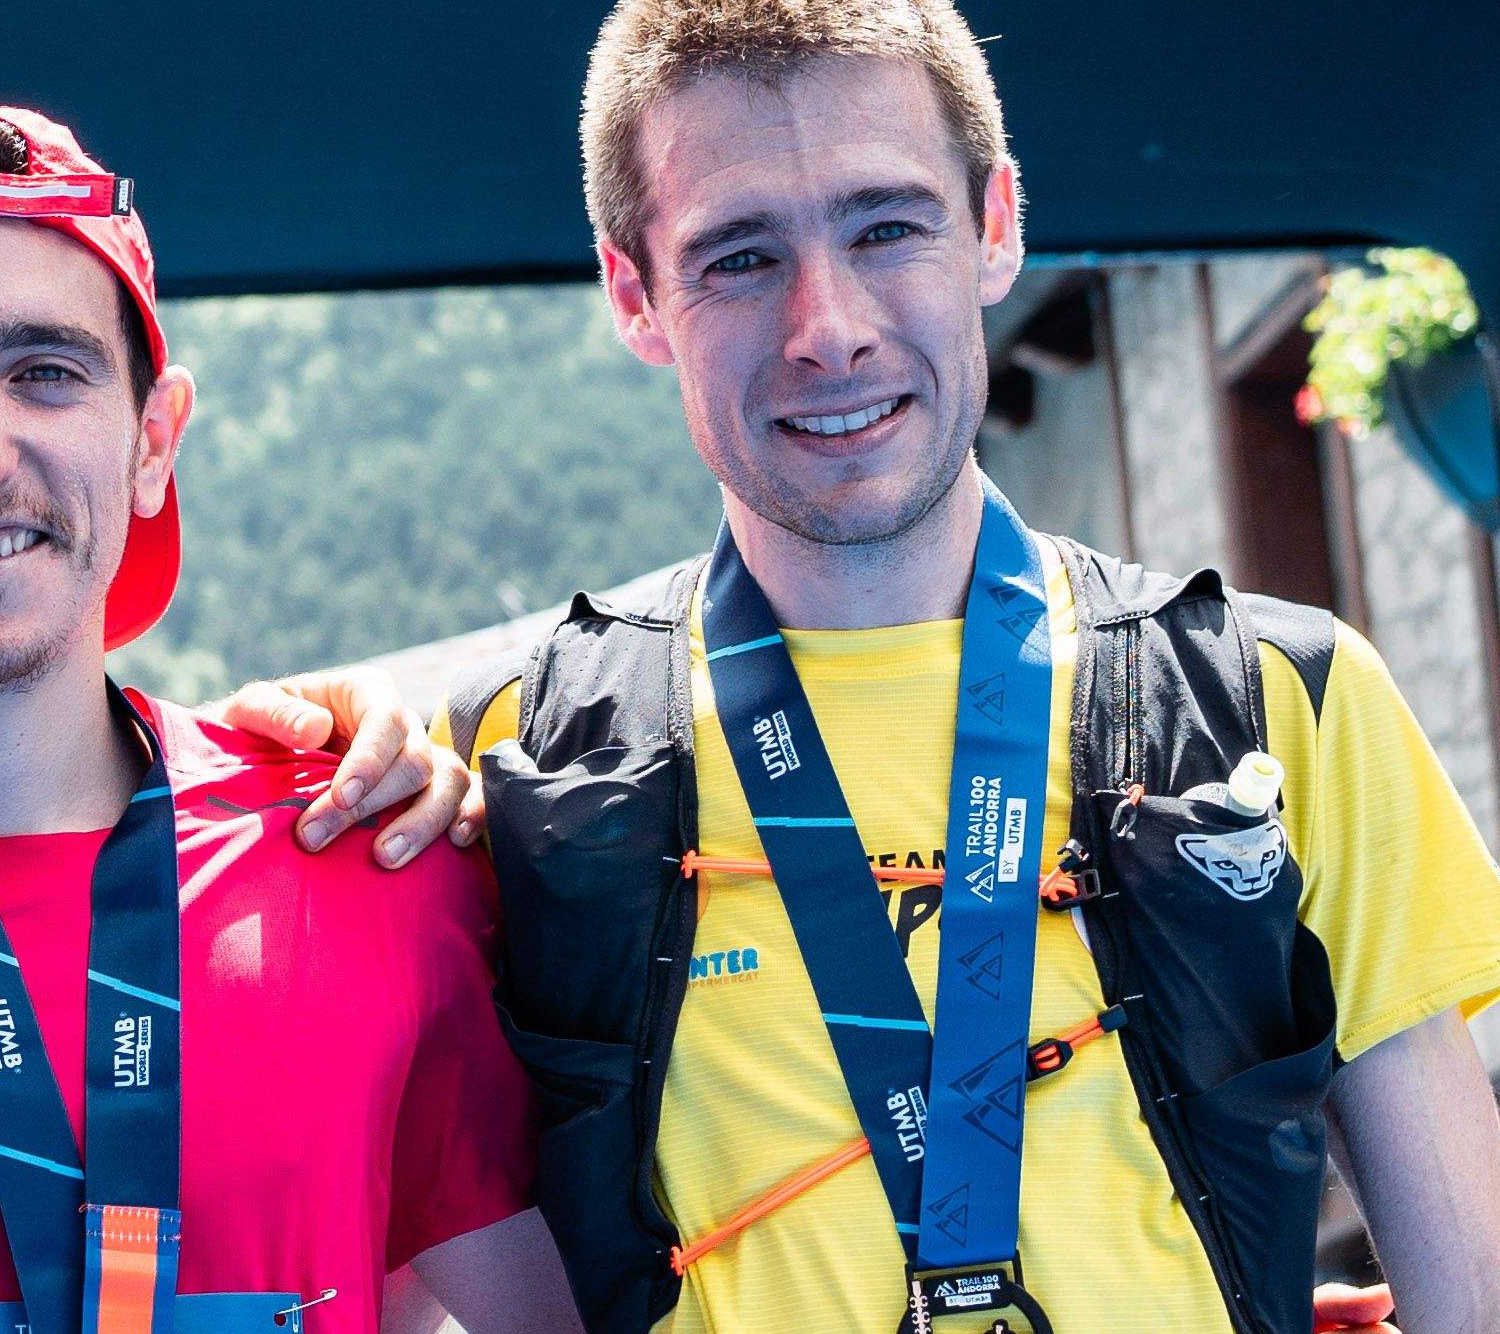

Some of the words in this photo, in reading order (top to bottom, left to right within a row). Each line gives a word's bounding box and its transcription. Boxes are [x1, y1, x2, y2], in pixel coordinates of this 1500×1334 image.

[752, 718, 787, 780] UTMB
[970, 775, 986, 807] 100
[965, 808, 984, 857] TRAIL
[982, 777, 1002, 857] ANDORRA
[1008, 809, 1022, 844] UTMB
[1003, 860, 1014, 875] BY
[141, 1018, 149, 1046] SERIES
[113, 1017, 135, 1087] UTMB
[138, 1048, 148, 1083] WORLD
[887, 1092, 925, 1162] UTMB
[957, 1282, 1000, 1294] ANDORRA
